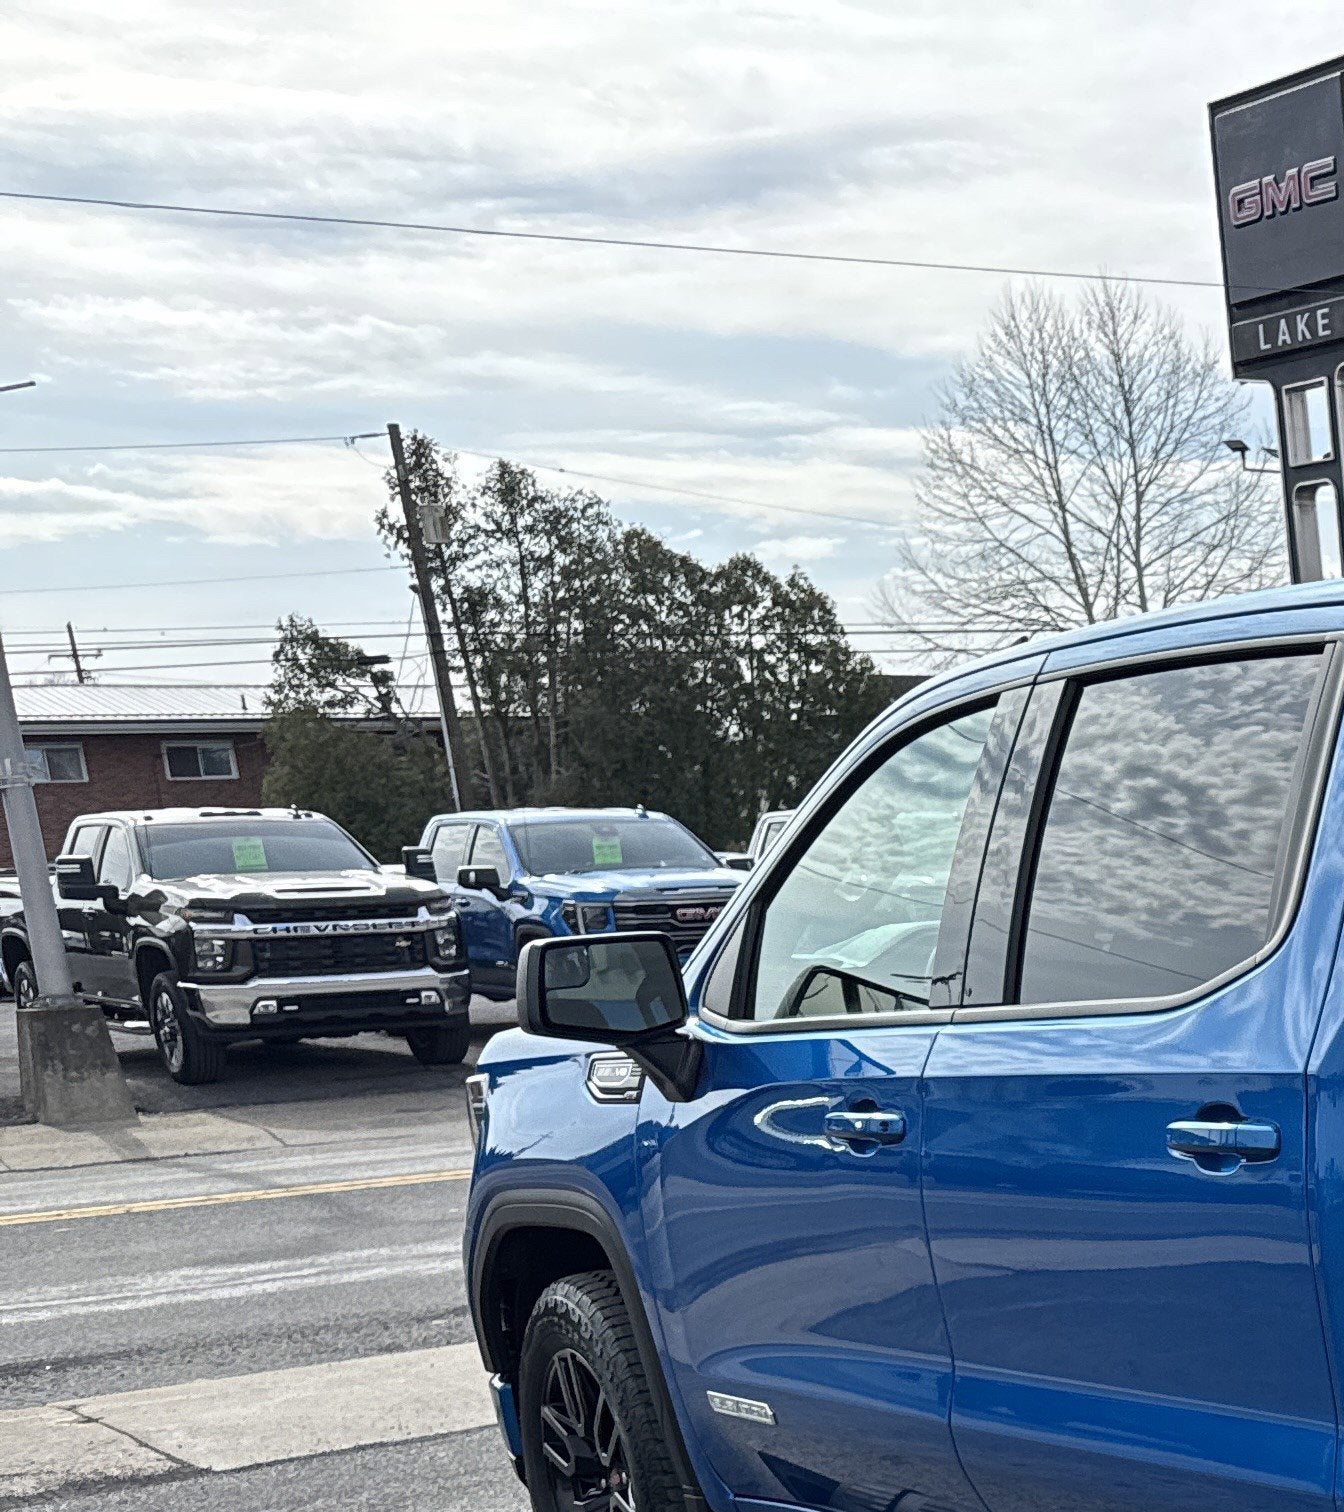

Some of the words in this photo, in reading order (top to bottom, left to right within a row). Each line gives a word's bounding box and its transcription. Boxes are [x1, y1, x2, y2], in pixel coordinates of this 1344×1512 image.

[1228, 155, 1338, 228] GMC
[1257, 307, 1332, 351] LAKE
[253, 920, 421, 936] CHEVROLET
